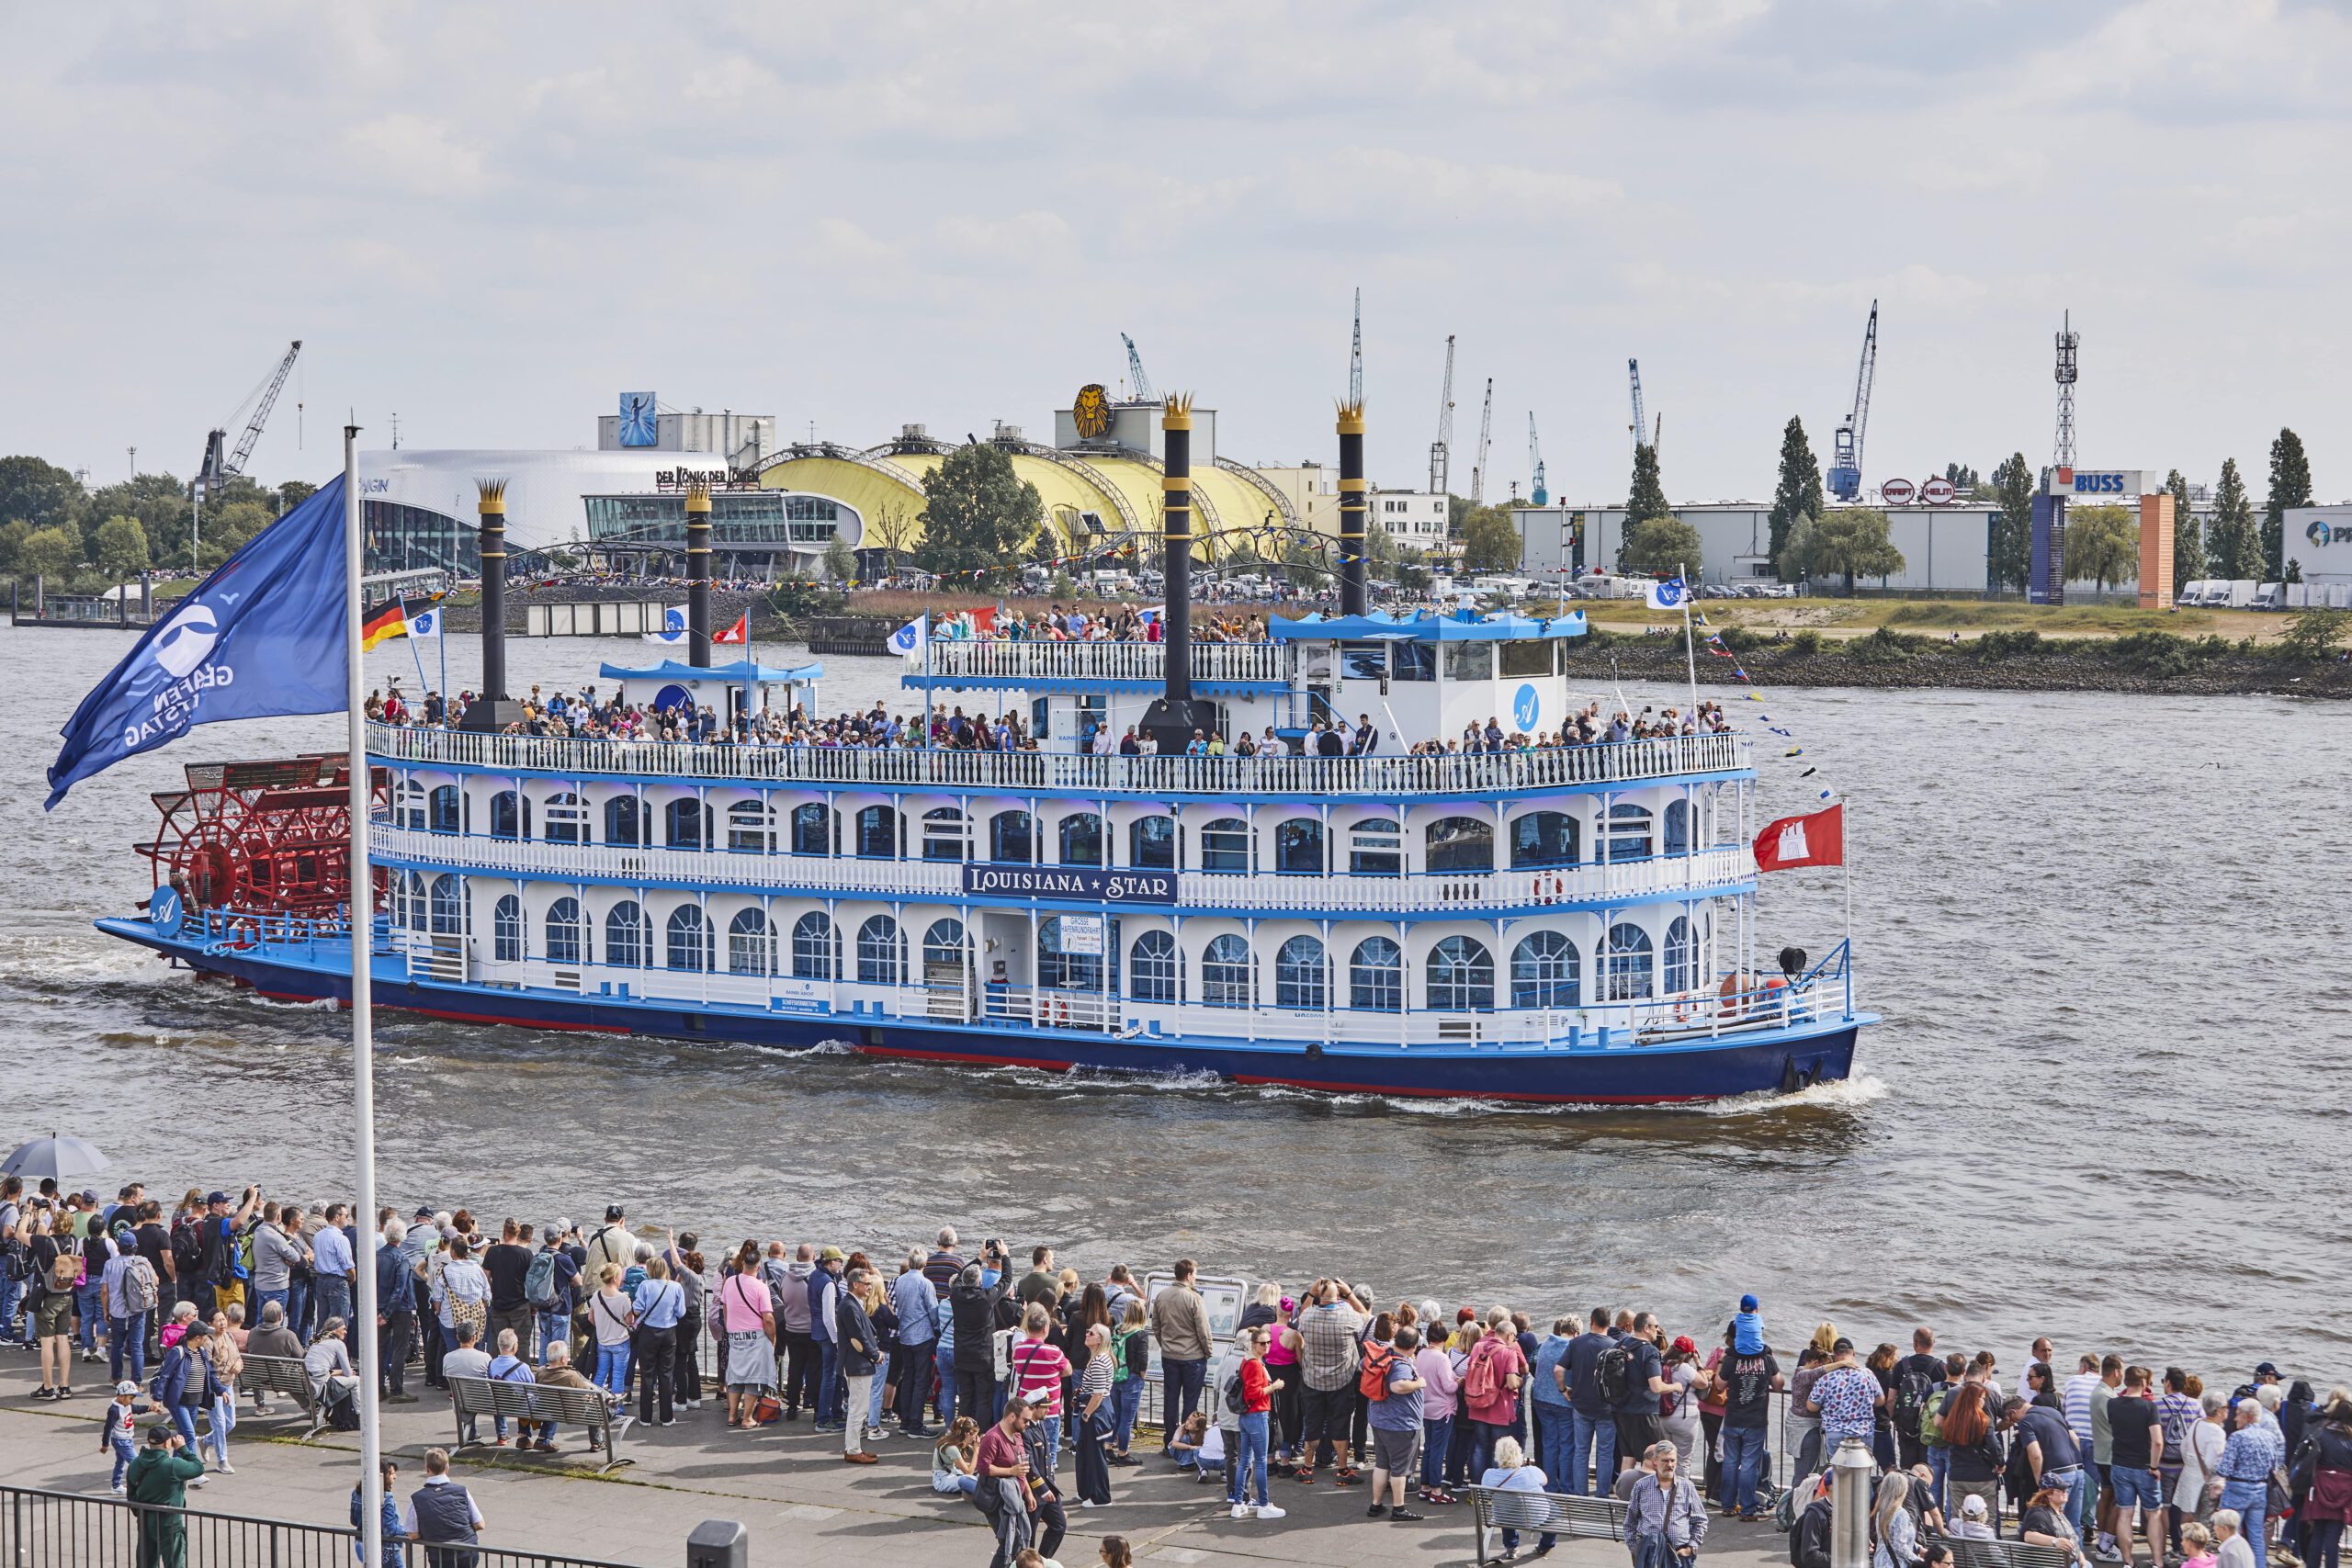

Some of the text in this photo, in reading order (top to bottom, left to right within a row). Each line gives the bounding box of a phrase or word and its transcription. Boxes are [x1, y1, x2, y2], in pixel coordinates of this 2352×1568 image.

[656, 466, 759, 488] DER KÖNIG DER LÖWEN
[2075, 474, 2124, 492] BUSS
[1925, 488, 1952, 496] HELM
[970, 868, 1169, 898] LOUISIANA STAR
[1070, 917, 1089, 926] GROSSE
[1060, 924, 1102, 935] HAFENRUNDFAHRT
